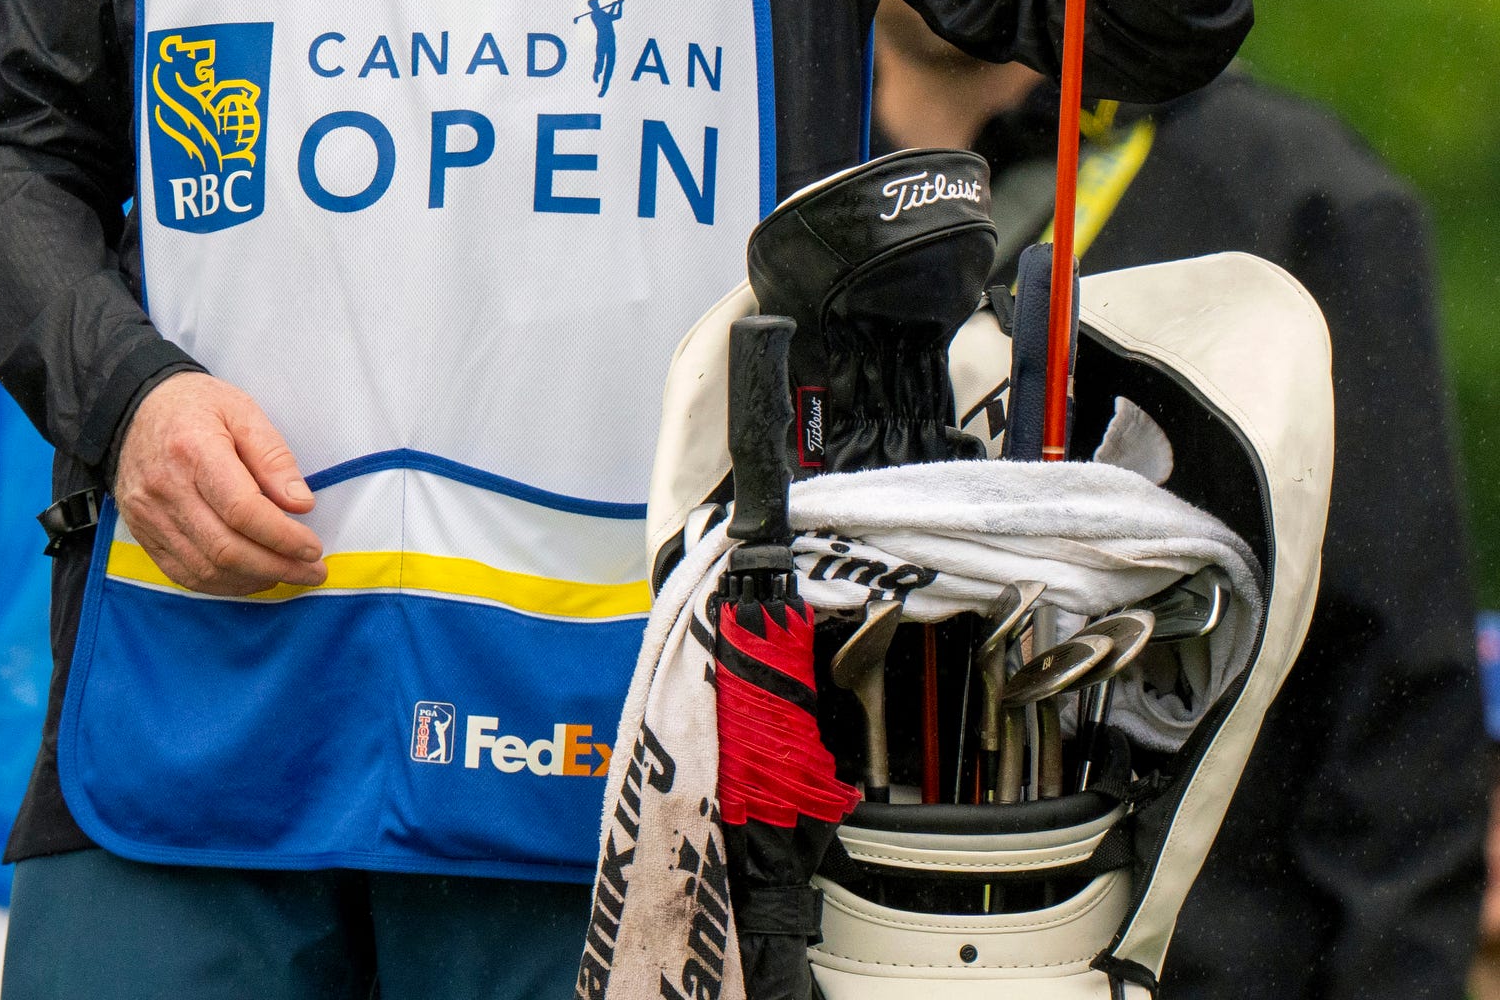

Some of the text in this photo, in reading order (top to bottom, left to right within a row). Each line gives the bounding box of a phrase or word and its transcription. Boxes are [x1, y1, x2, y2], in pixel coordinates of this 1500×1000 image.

[298, 109, 719, 226] OPEN
[168, 170, 253, 220] RBC
[880, 171, 982, 221] Titleist
[806, 396, 825, 456] Titleist
[414, 715, 431, 758] TOUR
[419, 709, 438, 717] PGA
